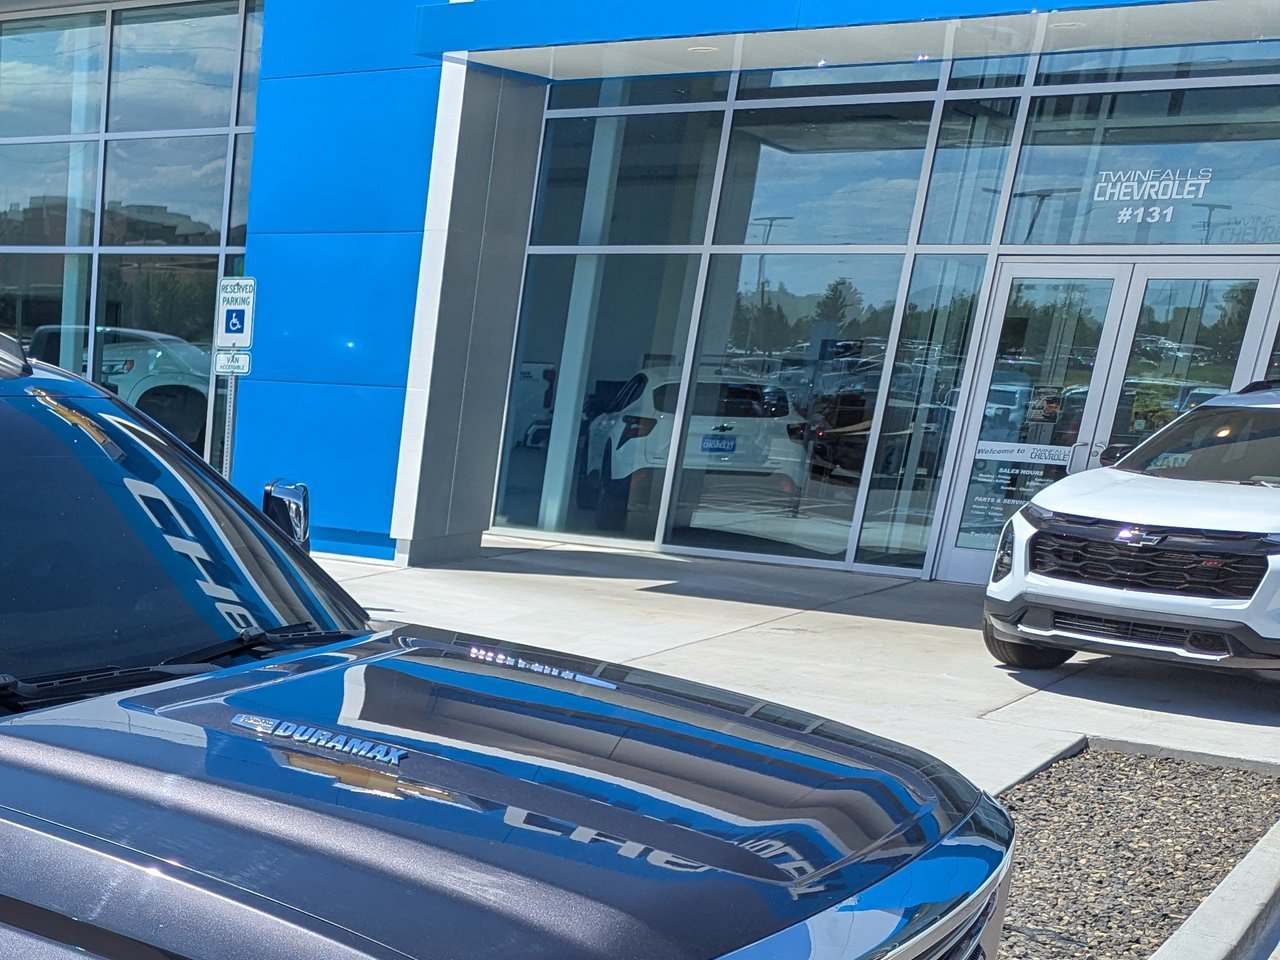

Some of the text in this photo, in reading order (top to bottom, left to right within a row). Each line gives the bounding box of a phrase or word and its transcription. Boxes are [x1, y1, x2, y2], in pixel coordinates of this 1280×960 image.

[1093, 179, 1211, 201] CHEVROLET
[1117, 206, 1174, 224] #131
[221, 284, 253, 294] RESERVED
[222, 297, 250, 306] PARKING
[226, 356, 240, 364] VAN
[1030, 452, 1071, 460] CHEVROLE
[273, 721, 408, 765] DURAMAX
